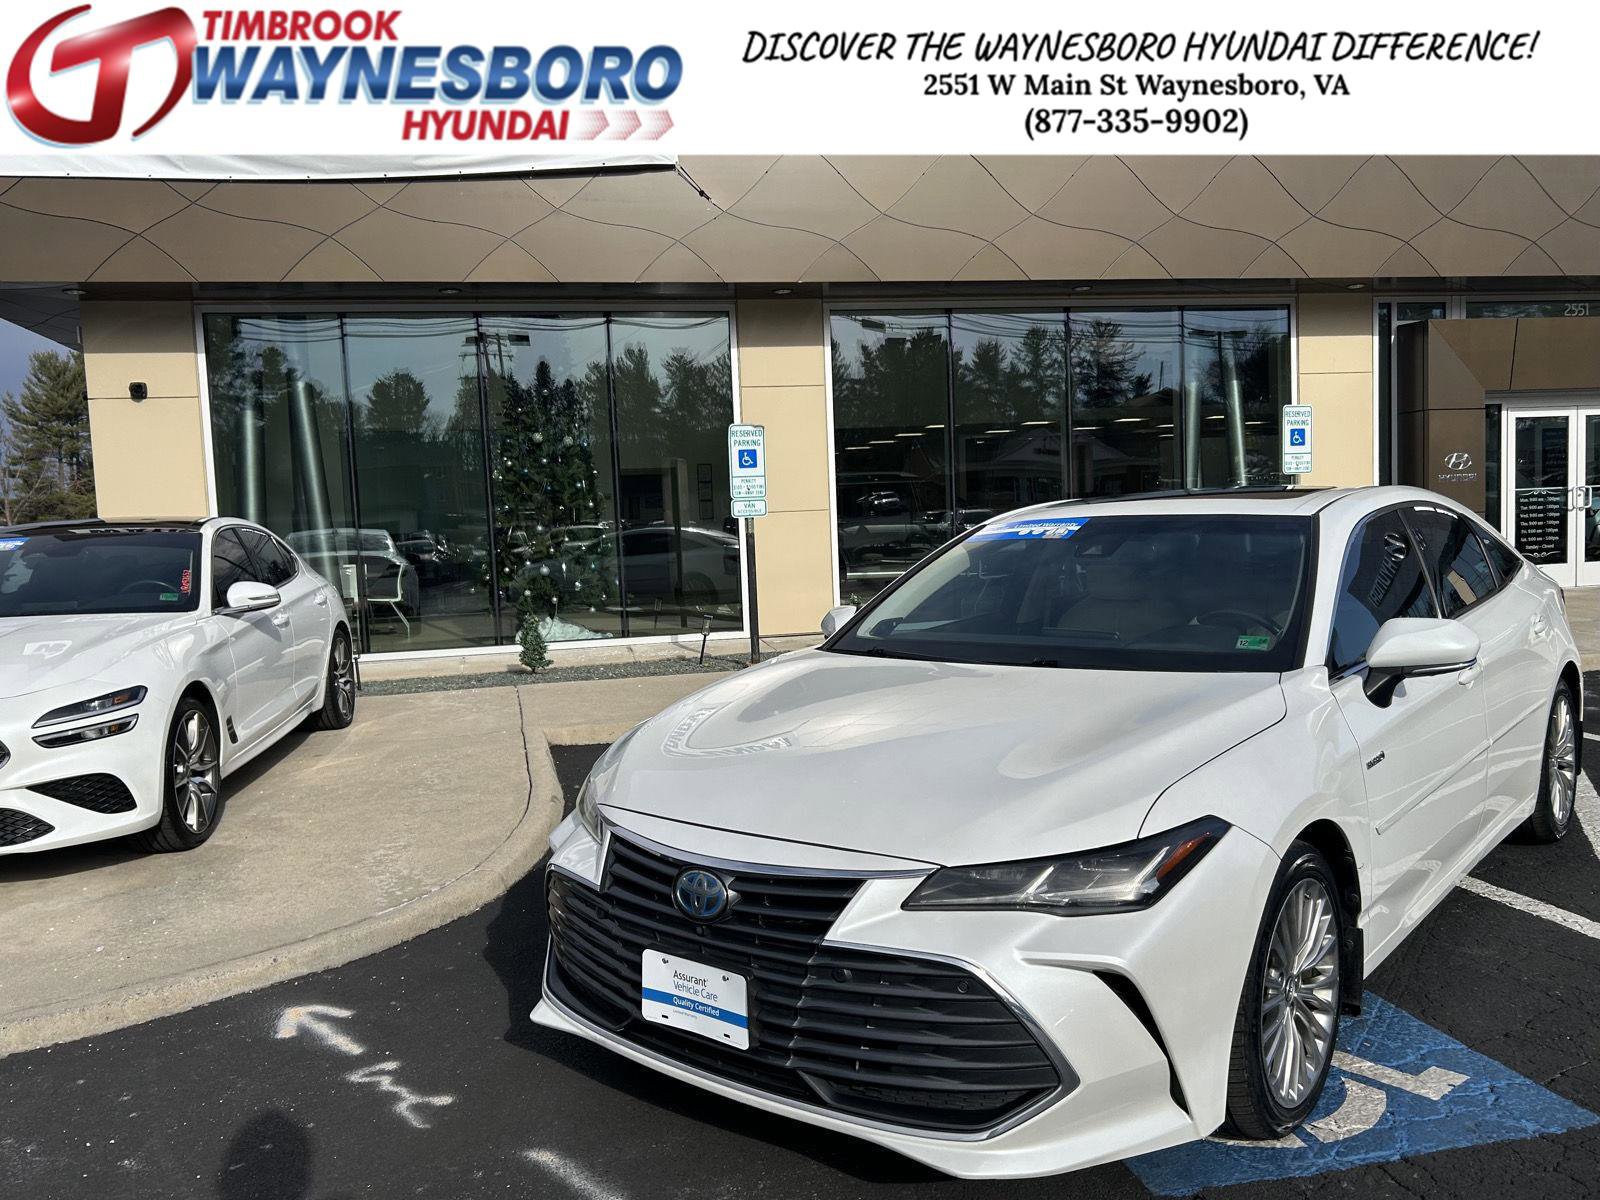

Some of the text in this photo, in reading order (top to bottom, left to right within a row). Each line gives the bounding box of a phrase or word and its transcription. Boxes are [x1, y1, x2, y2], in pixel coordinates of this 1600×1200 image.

[1564, 303, 1589, 316] 2551
[732, 430, 762, 438] RESERVED
[673, 970, 707, 987] Assurant
[673, 980, 718, 1002] Vehicle Care
[673, 997, 720, 1016] Quality Certified
